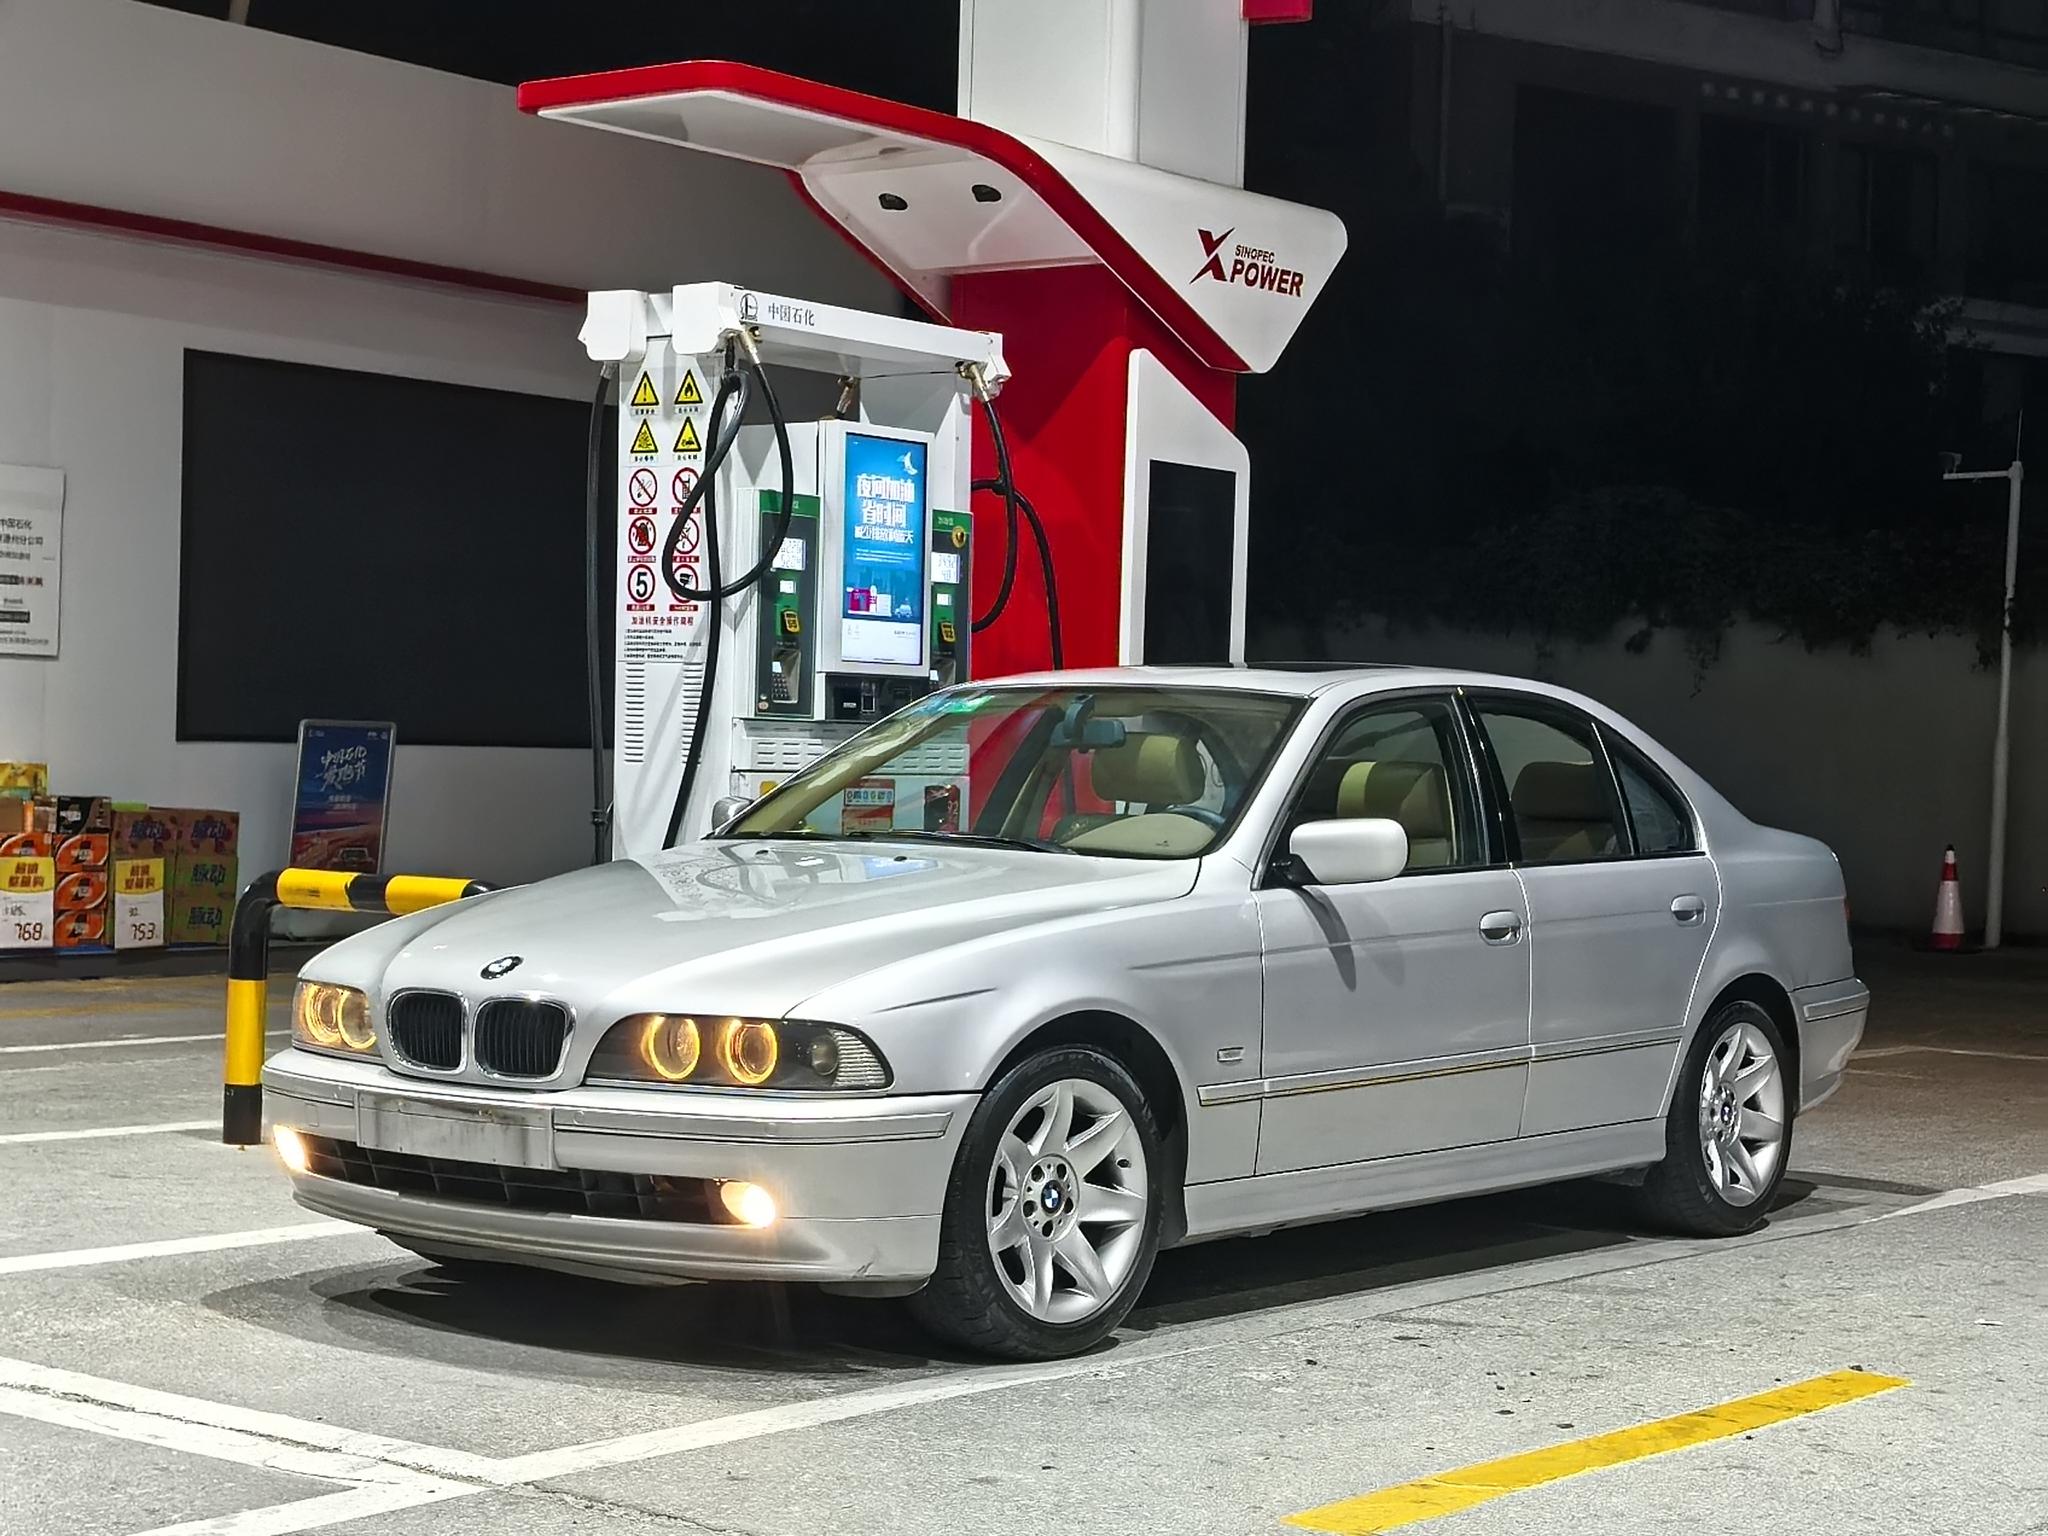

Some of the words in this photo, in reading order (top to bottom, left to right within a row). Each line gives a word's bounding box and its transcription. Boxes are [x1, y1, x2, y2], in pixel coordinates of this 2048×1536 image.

[1235, 244, 1275, 264] SINOPEC
[1229, 258, 1304, 298] POWER
[768, 302, 815, 326] 中国石化
[862, 499, 907, 529] 省时间
[635, 571, 648, 598] 5
[14, 922, 43, 941] 768
[131, 922, 156, 941] 753
